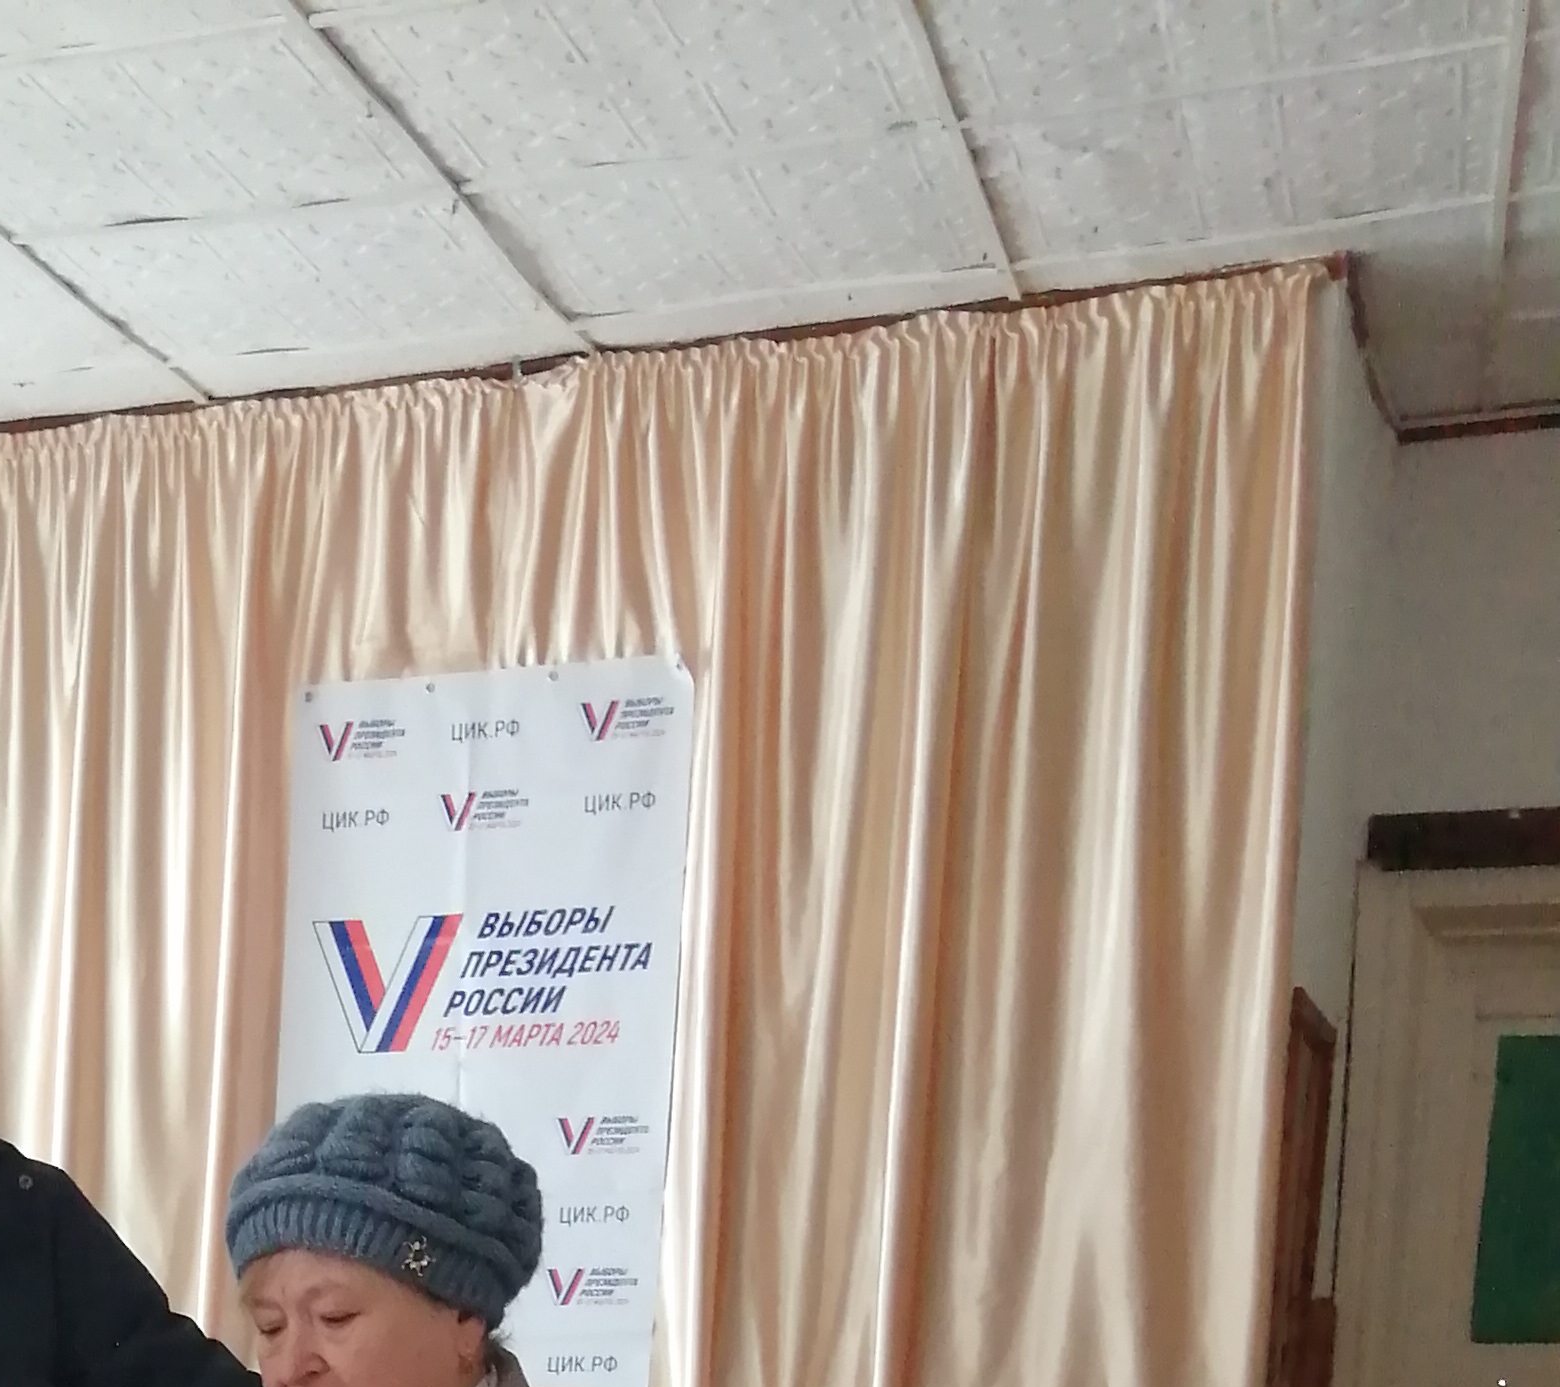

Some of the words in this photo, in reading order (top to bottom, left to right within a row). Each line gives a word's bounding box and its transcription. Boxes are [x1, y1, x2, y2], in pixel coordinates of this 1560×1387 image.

[450, 718, 520, 743] ЦИК.РФ
[477, 905, 615, 939] ВЫБОРЫ
[460, 942, 653, 979] ПРЕЗИДЕНТА
[443, 985, 566, 1018] РОССИИ
[489, 1023, 565, 1049] МАРТА
[567, 1020, 620, 1046] 2024
